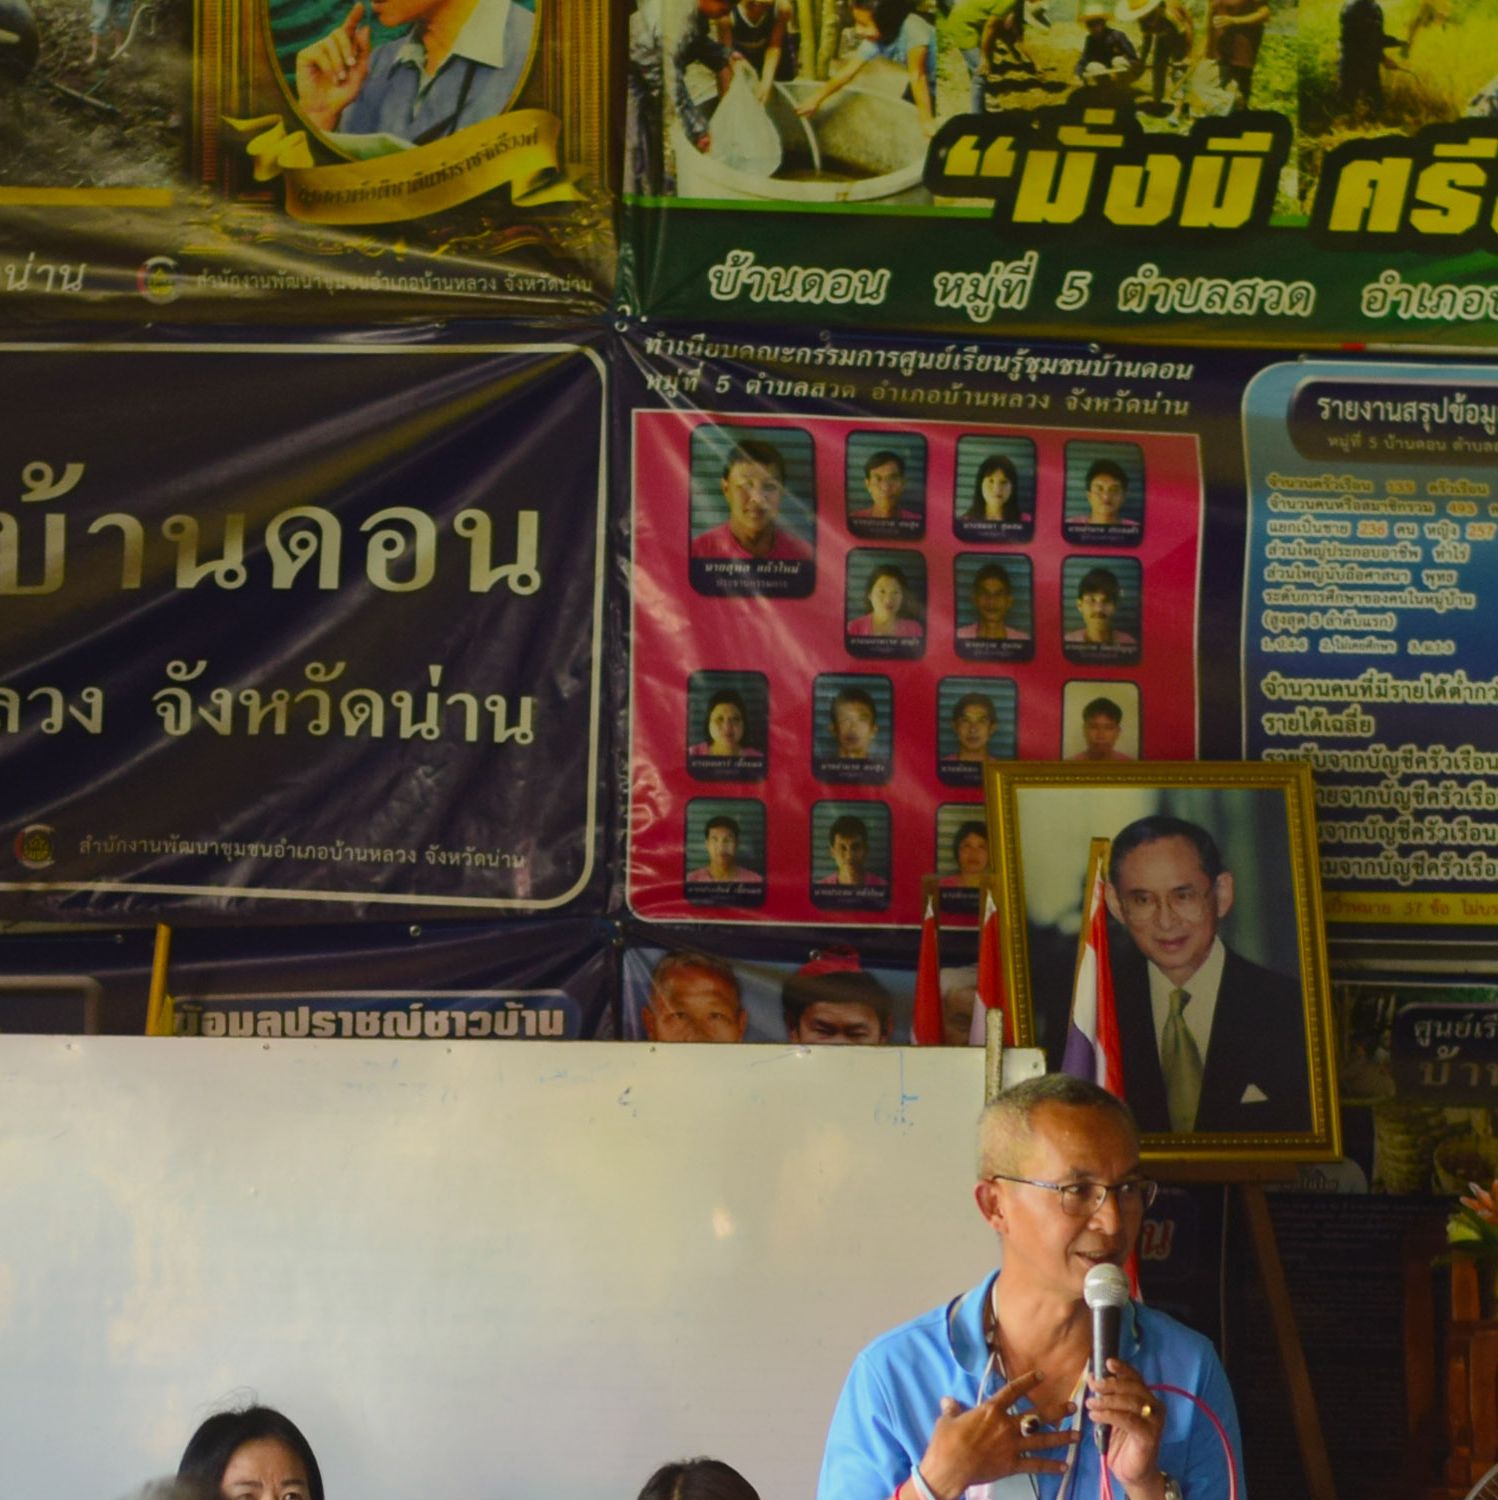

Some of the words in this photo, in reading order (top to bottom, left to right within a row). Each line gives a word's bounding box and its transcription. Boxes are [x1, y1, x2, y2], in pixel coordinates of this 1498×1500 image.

[708, 251, 891, 306] บ้านดอน
[934, 257, 1034, 322] หมู่ที่
[1057, 270, 1090, 310] 5
[1118, 264, 1315, 319] ตำบลสวด
[715, 374, 732, 394] 5
[745, 371, 857, 399] ตำบลสวด
[871, 379, 1051, 410] อำเภอบ้านหลวง
[1064, 386, 1191, 416] จังหวัดน่าน
[1327, 430, 1363, 453] หมู่ที่
[1369, 436, 1378, 449] 5
[1383, 433, 1447, 452] บ้านดอน
[1427, 479, 1489, 496] ครัวเรือน
[1269, 495, 1434, 516] จำนวนคนหรือสมาชิกรวม
[1268, 517, 1349, 537] แยกเป็นชาย
[1395, 523, 1417, 538] คน
[1425, 521, 1458, 541] หญิง
[1466, 524, 1496, 539] 257
[1267, 540, 1420, 562] ส่วนใหญ่ประกอบอาชีพ
[1264, 587, 1475, 612] ระดับการศึกษาของคนในหมู่บ้าน
[151, 658, 535, 747] จังหวัดน่าน
[1263, 705, 1375, 736] รายได้เฉลี่ย
[78, 831, 418, 869] สำนักงานพัฒนาชุมชนอำเภอบ้านหลวง
[423, 842, 525, 873] จังหวัดน่าน
